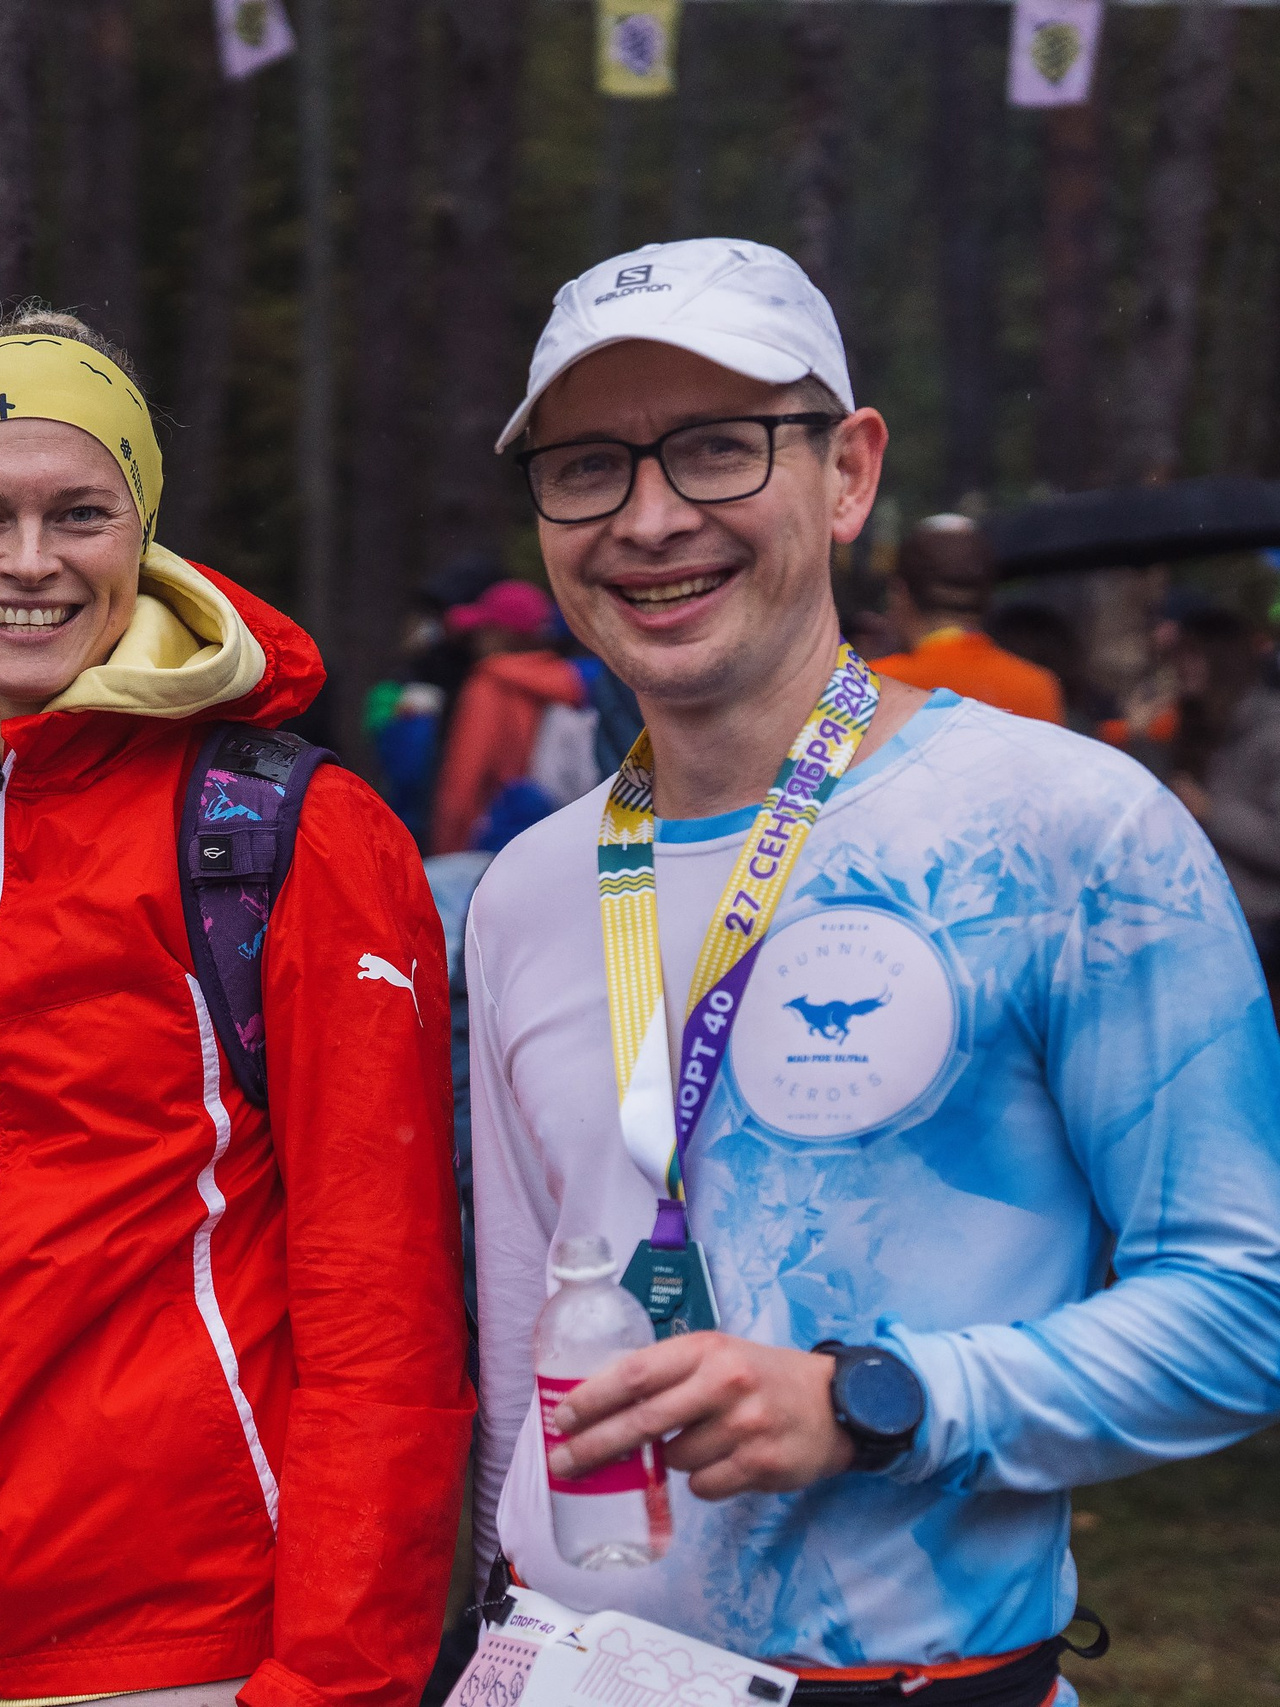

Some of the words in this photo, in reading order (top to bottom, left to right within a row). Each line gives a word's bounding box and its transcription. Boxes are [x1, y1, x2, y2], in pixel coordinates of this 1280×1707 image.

[595, 284, 672, 306] salomon
[725, 889, 761, 937] 27
[749, 718, 849, 880] СЕНТЯБРЯ
[777, 942, 905, 978] RUNNING
[702, 990, 734, 1035] 40
[772, 1073, 882, 1102] HEROES
[510, 1614, 541, 1631] СПОРТ
[540, 1622, 556, 1635] 40
